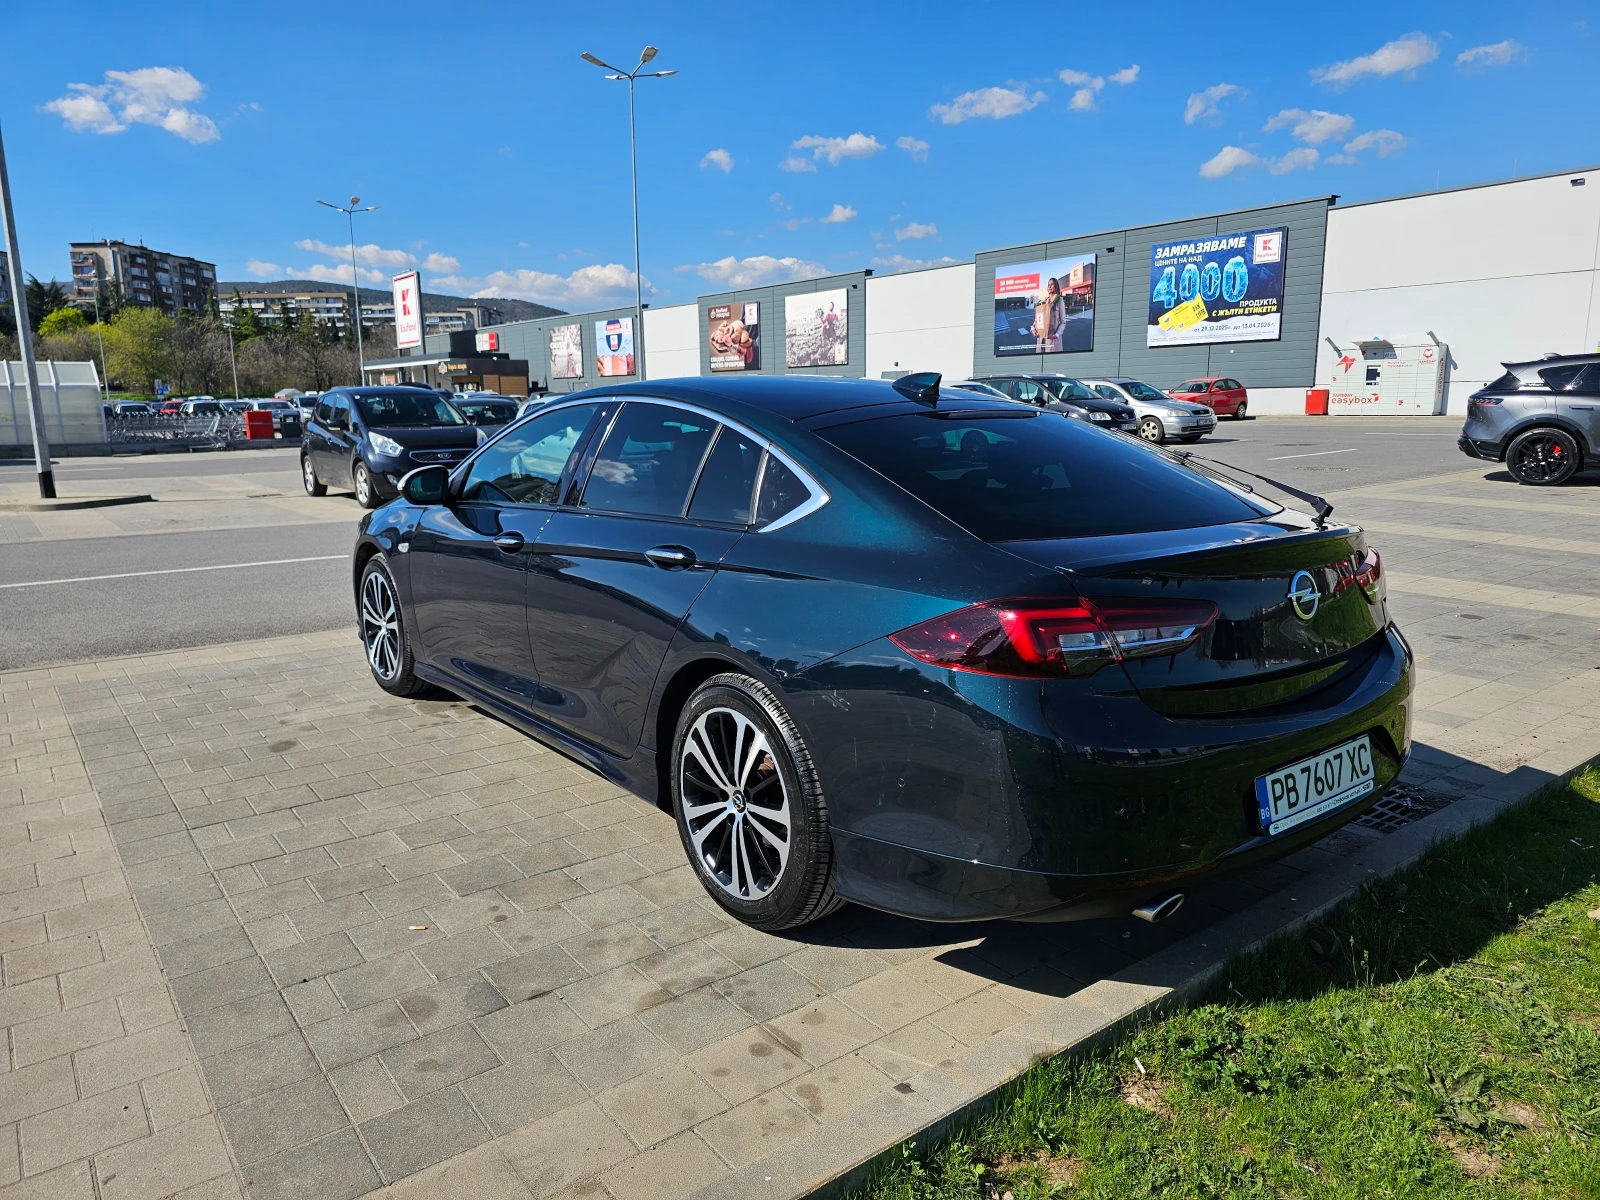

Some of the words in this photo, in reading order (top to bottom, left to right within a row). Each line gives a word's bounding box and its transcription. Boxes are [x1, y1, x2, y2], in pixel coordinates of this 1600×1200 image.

[1156, 237, 1247, 258] ЗАМРАЗЯВАМЕ
[1155, 258, 1178, 267] ЦЕНИТЕ
[1178, 256, 1187, 264] НА
[1188, 255, 1203, 263] НАД
[1153, 256, 1248, 308] 4000
[1239, 298, 1277, 308] ПРОДУКТА
[1218, 308, 1243, 316] ЖЪЛТИ
[1244, 305, 1277, 314] ЕТИКЕТИ
[400, 321, 417, 333] Kaufland
[1331, 396, 1373, 405] easybox
[1260, 807, 1270, 819] BG
